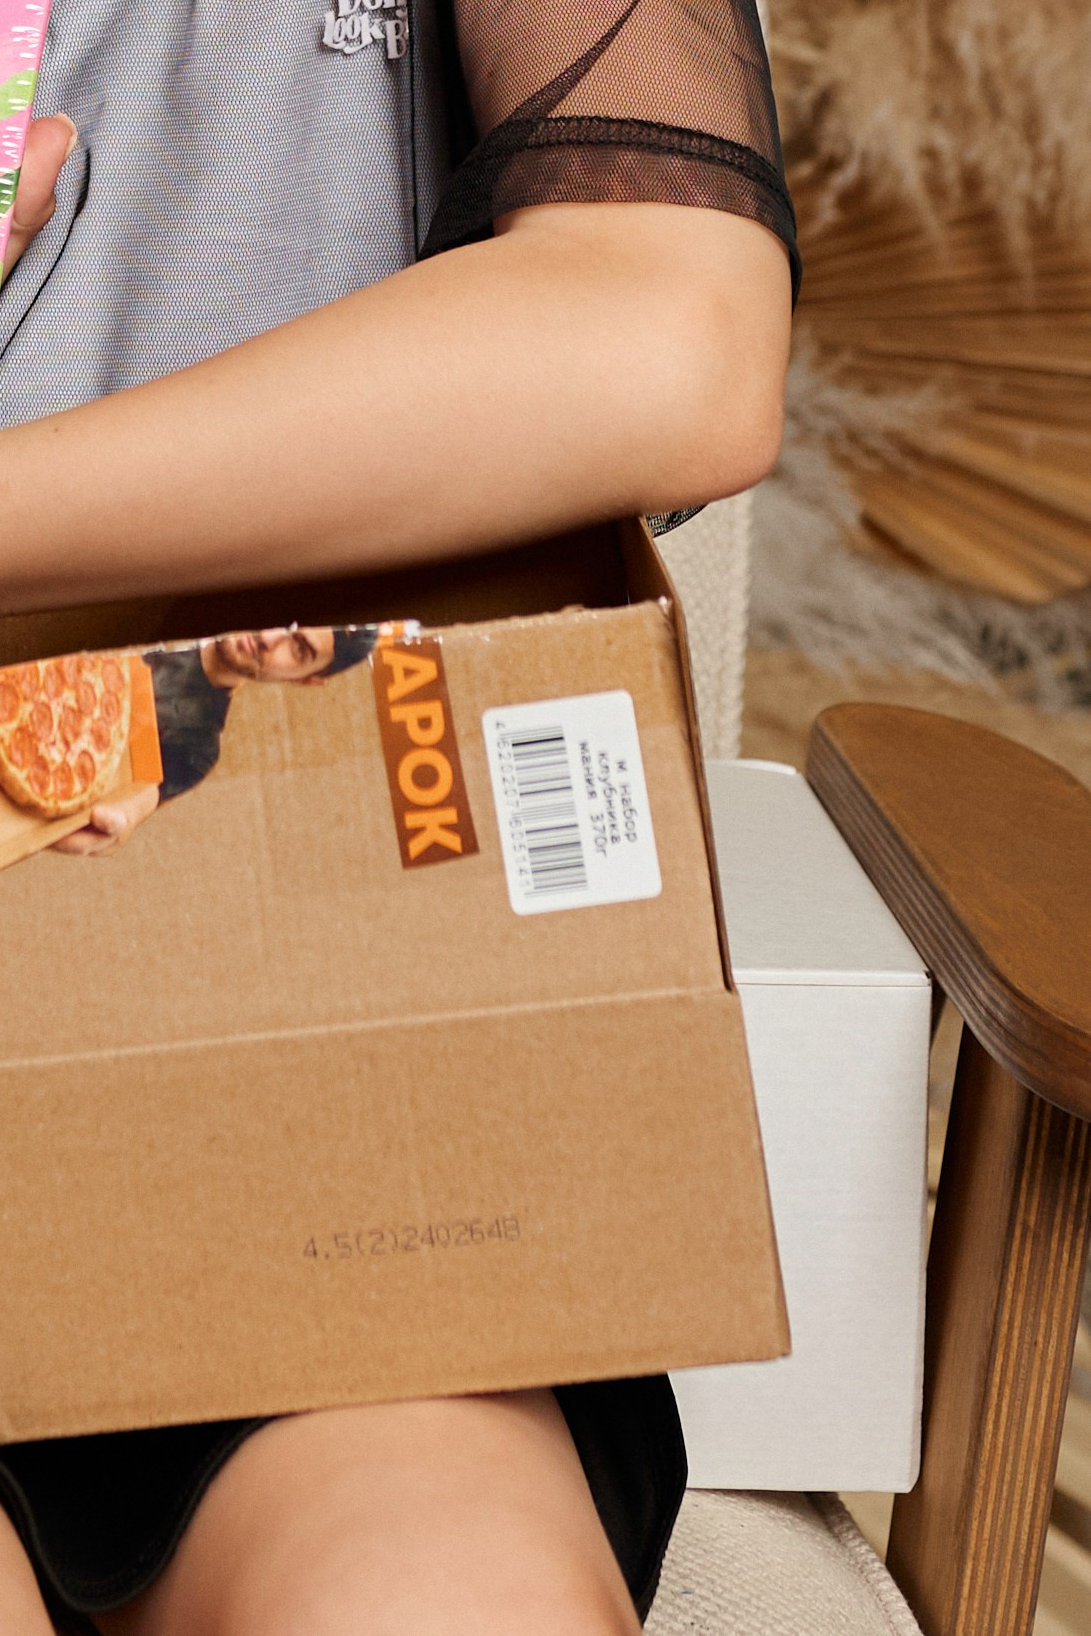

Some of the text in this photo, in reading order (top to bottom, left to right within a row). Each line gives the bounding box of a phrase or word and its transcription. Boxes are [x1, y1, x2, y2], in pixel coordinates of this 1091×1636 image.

[579, 740, 598, 800] мания
[598, 752, 622, 845] клубника
[620, 783, 639, 843] набор
